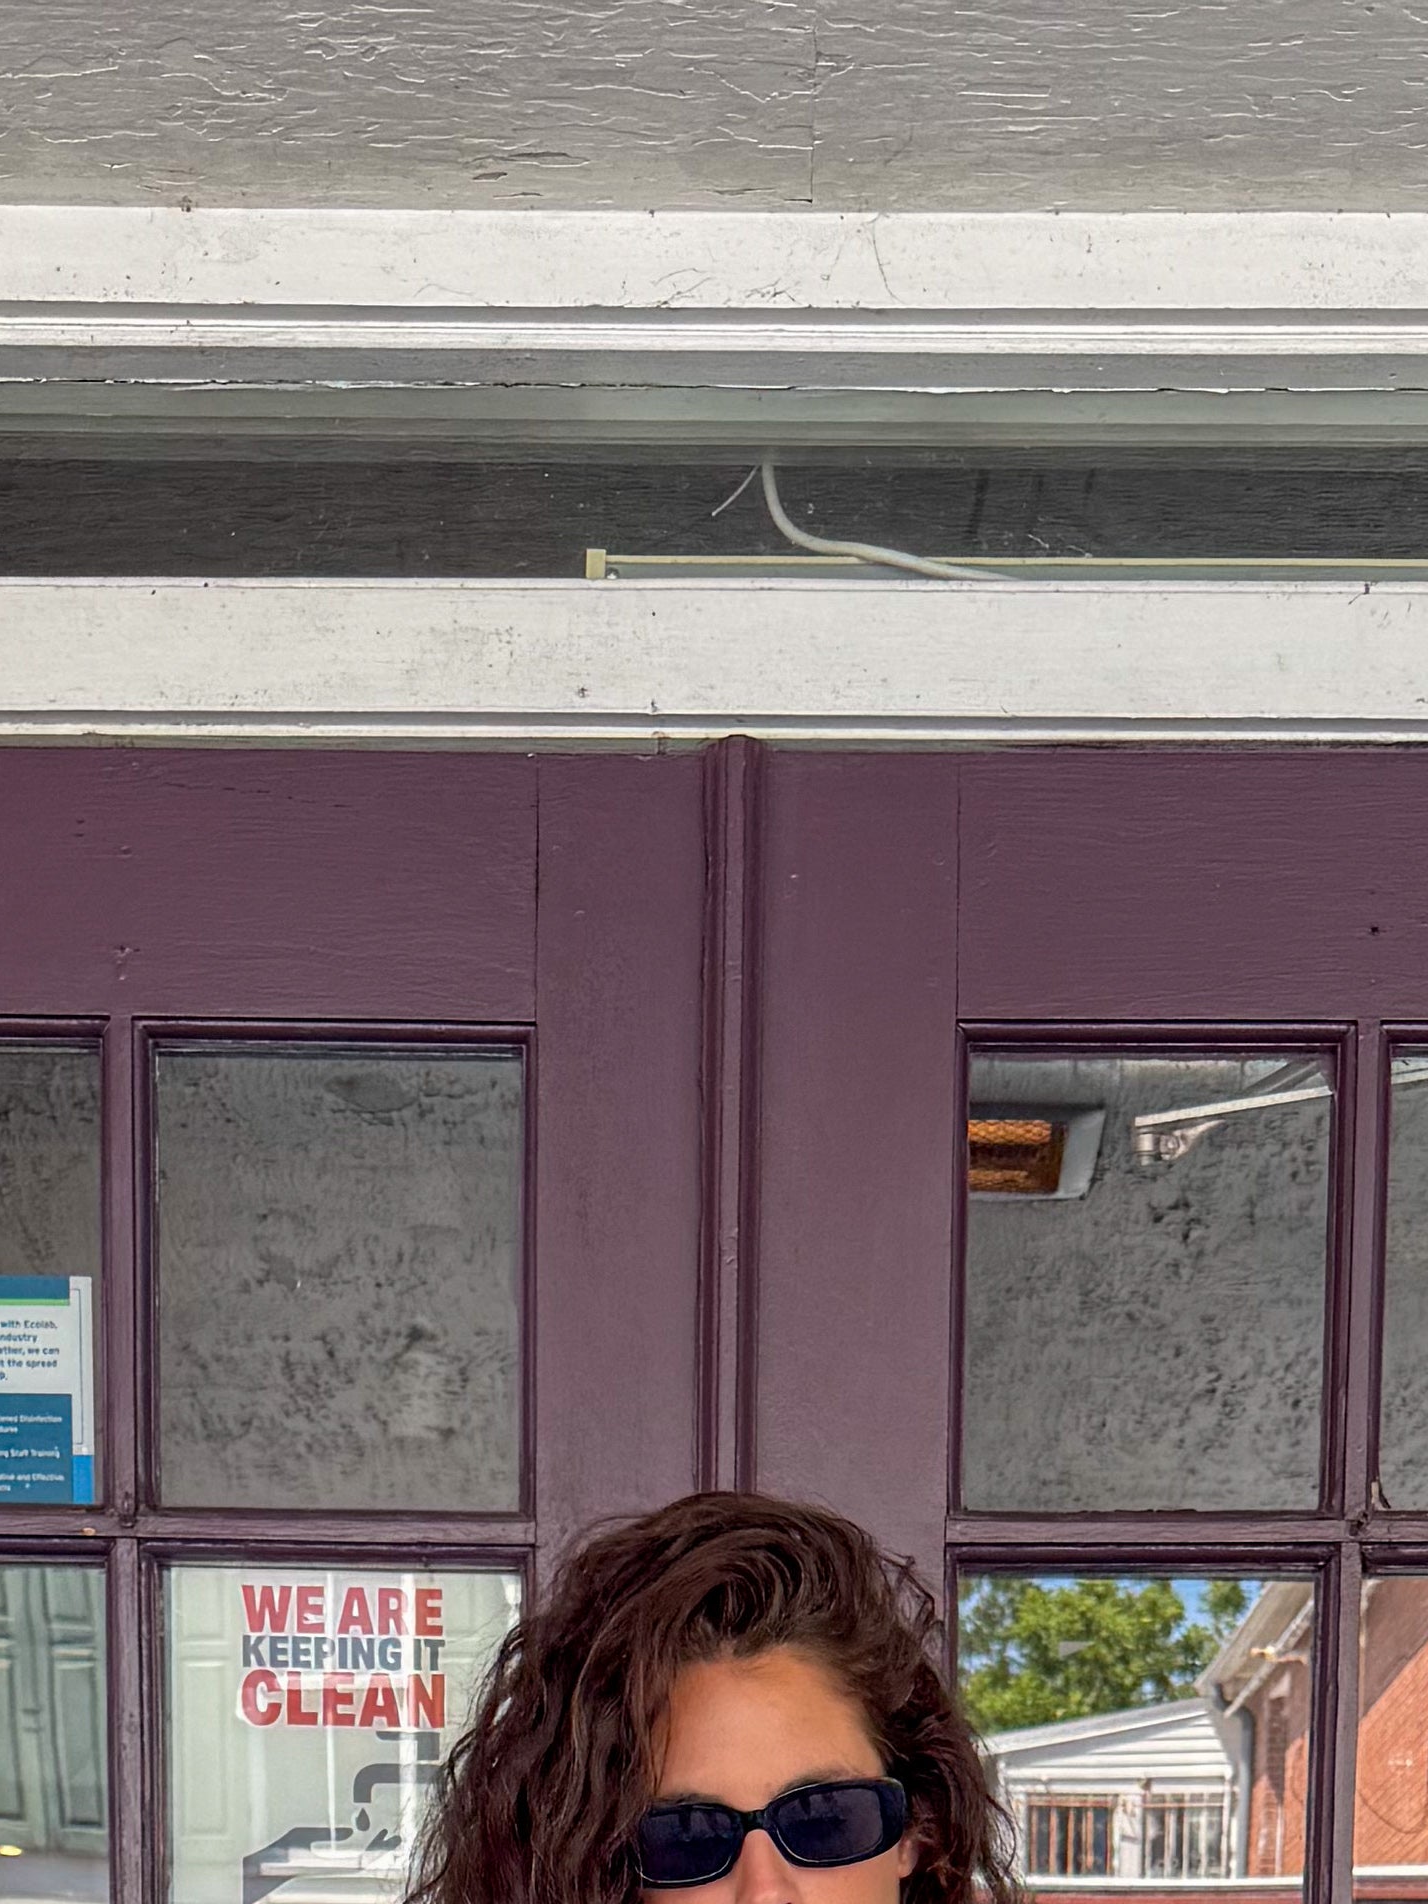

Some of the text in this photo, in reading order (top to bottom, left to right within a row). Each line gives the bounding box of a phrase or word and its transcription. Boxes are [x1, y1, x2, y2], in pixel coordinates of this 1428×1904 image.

[1, 1320, 21, 1328] with
[7, 1359, 23, 1367] the
[25, 1359, 57, 1368] spread
[242, 1585, 443, 1636] WE ARE
[243, 1637, 445, 1671] KEEPING IT
[241, 1670, 445, 1727] CLEAN
